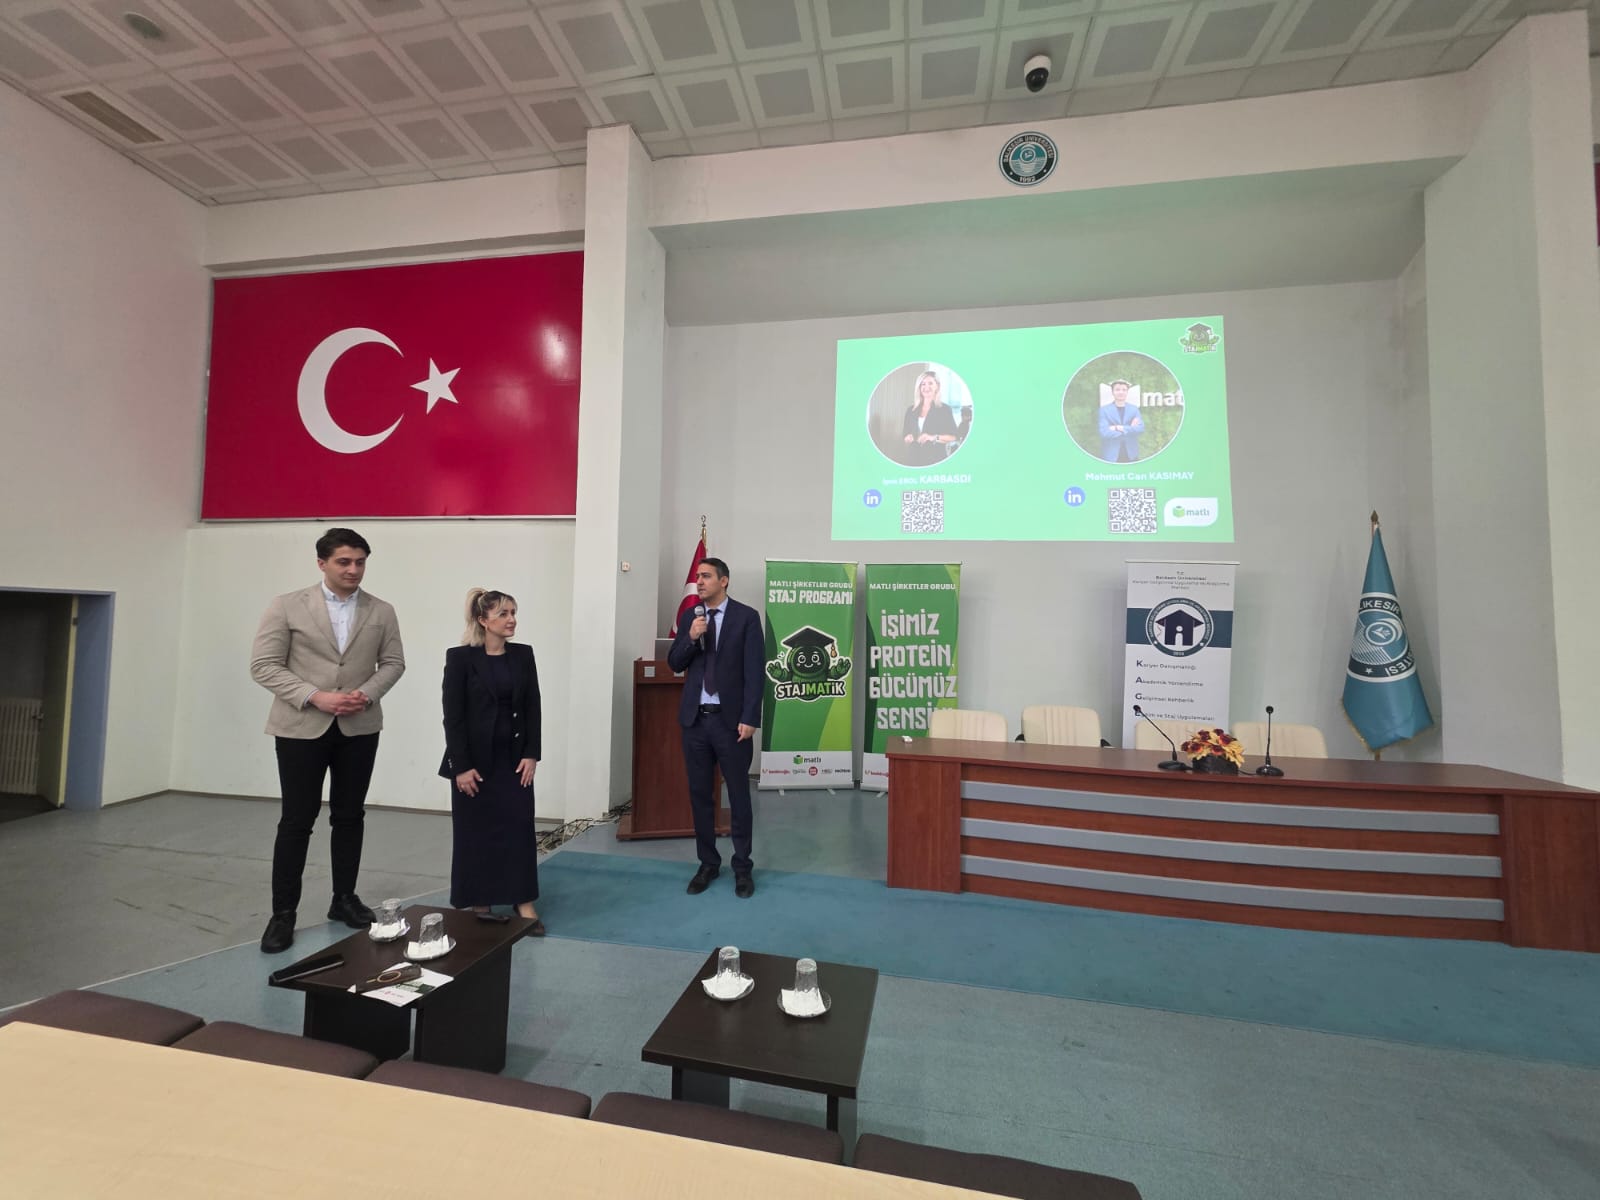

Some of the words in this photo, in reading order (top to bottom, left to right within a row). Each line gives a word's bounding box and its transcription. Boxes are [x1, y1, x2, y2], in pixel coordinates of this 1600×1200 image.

[1149, 471, 1194, 480] KASIMAY
[866, 494, 879, 505] in
[1067, 490, 1082, 504] in
[768, 589, 797, 603] STAJ
[799, 590, 853, 605] PROGRAMI
[881, 608, 940, 639] İŞİMİZ
[869, 673, 957, 699] GÜCÜMÜZ
